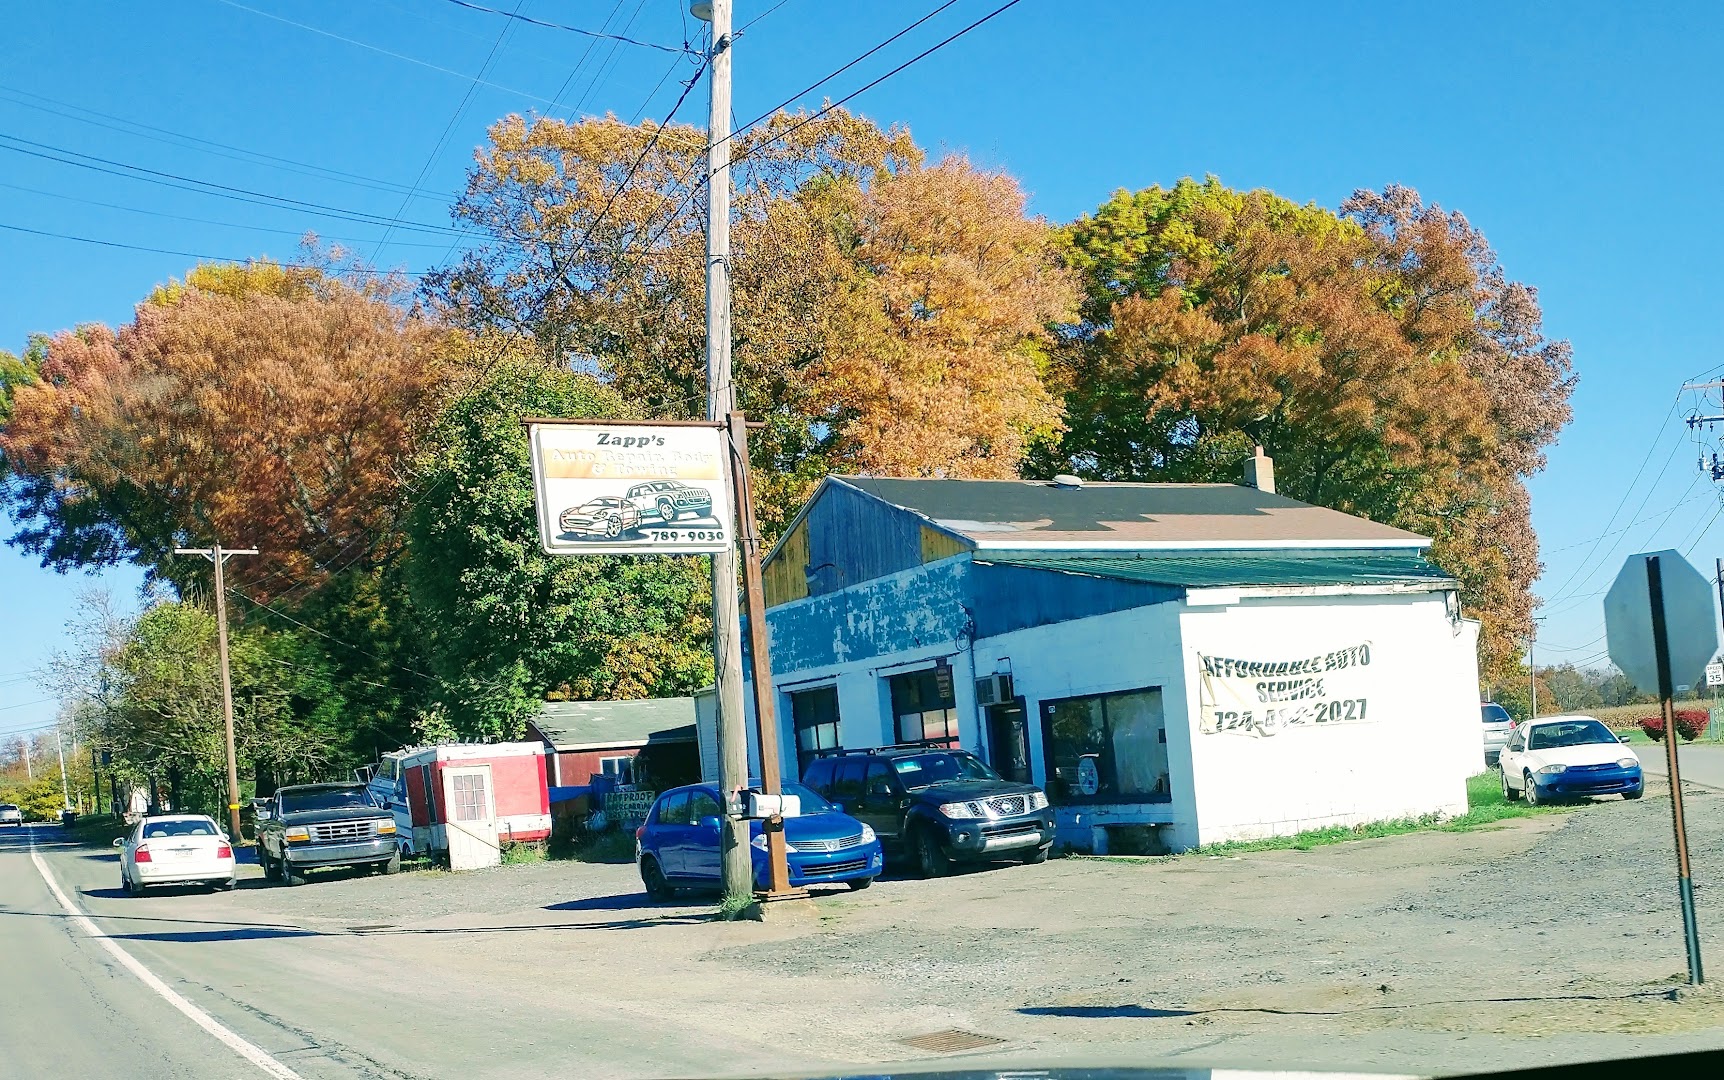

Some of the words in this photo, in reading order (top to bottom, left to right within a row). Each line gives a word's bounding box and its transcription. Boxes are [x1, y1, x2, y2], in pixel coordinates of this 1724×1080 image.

[597, 433, 665, 448] Zapp's
[552, 448, 597, 462] Auto
[601, 449, 665, 463] Repair
[614, 462, 678, 477] Towing
[650, 531, 724, 542] 789-9030
[1325, 643, 1371, 672] AUTO
[1709, 674, 1722, 683] 35
[1256, 678, 1327, 703] SERVICE
